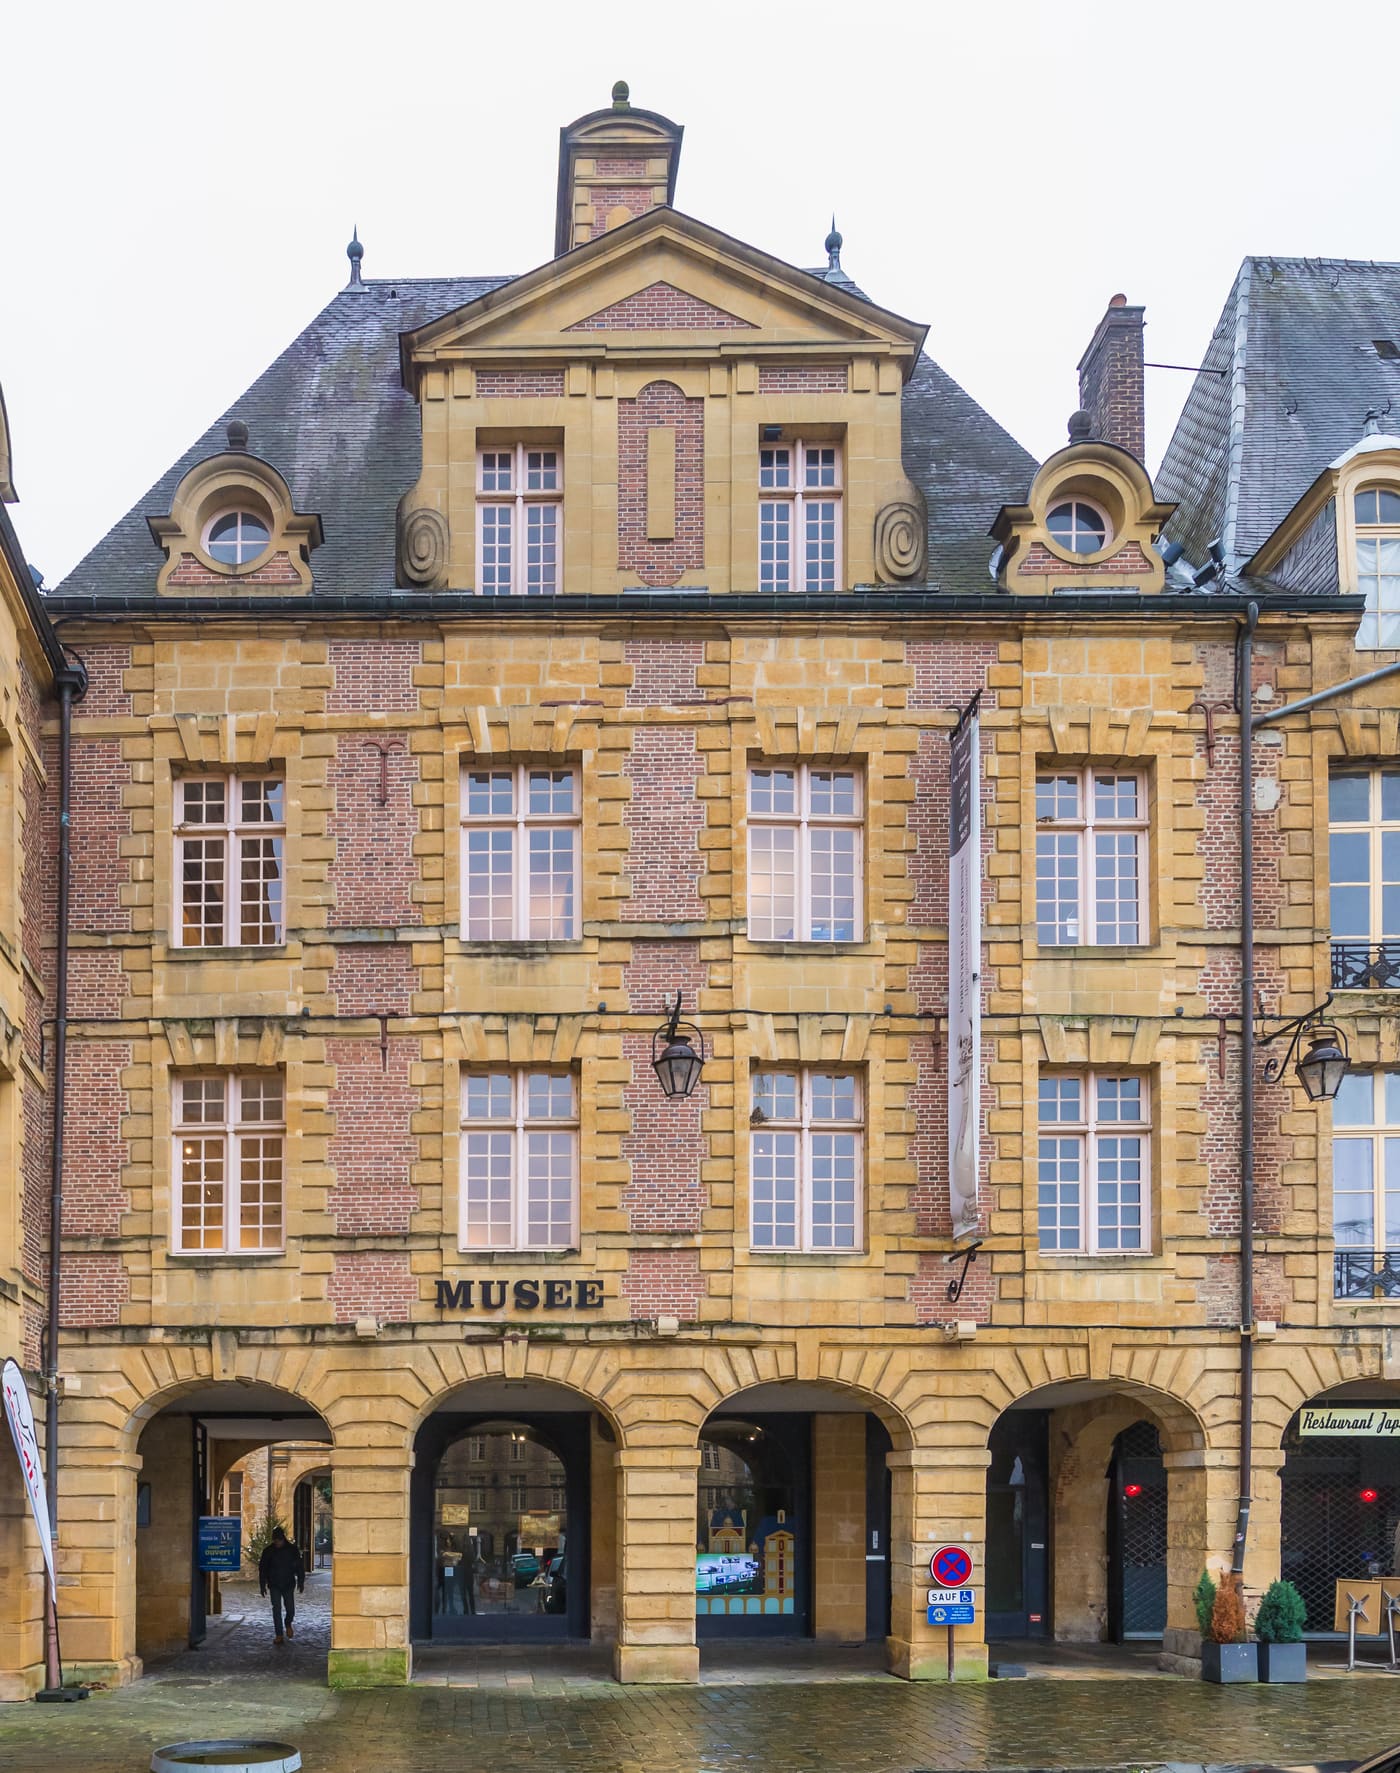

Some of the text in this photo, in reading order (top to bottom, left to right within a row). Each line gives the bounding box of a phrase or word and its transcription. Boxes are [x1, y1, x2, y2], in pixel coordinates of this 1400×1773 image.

[434, 1279, 604, 1309] MUSEE
[1302, 1411, 1400, 1434] Restaurant Jap
[931, 1592, 957, 1602] SAUF
